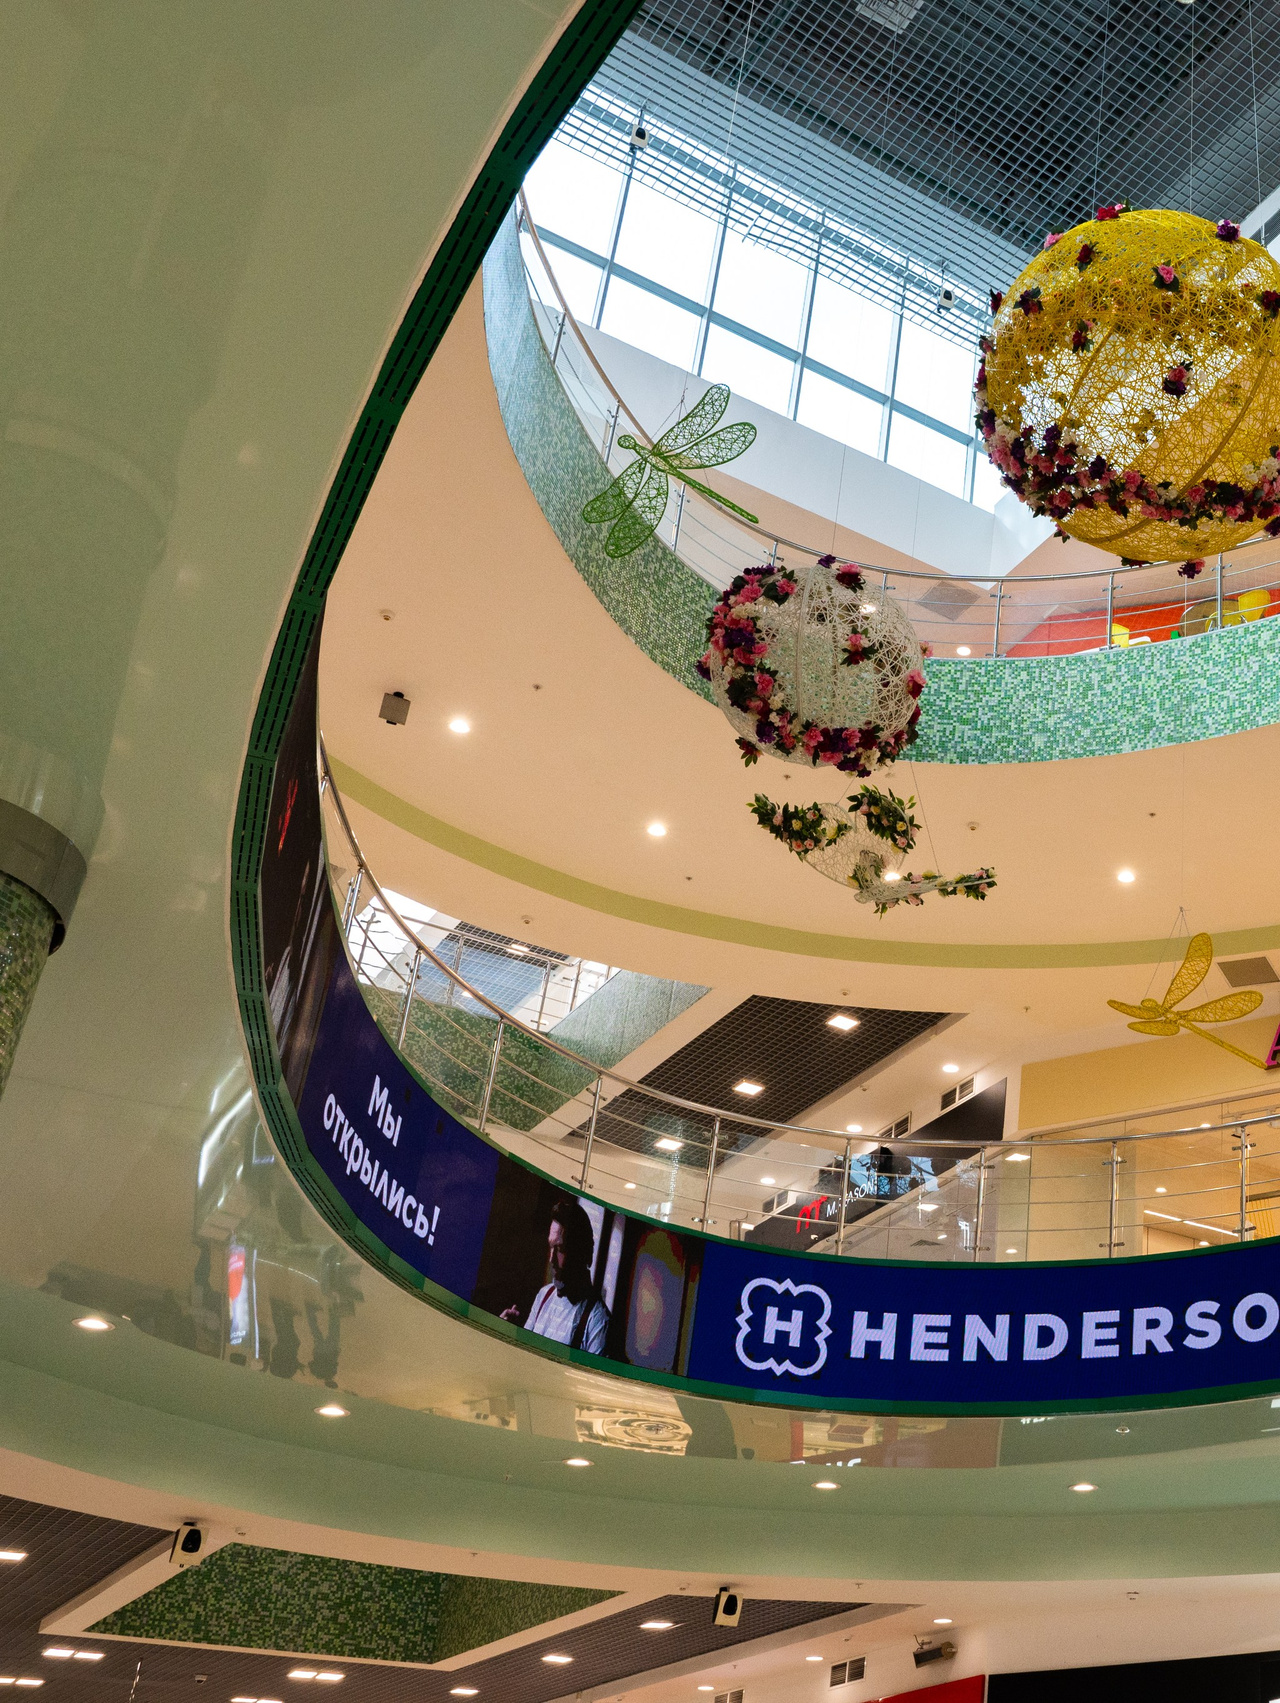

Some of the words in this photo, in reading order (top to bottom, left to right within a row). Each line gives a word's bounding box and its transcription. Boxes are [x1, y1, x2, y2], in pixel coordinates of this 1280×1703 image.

[367, 1074, 403, 1147] Мы
[323, 1093, 441, 1246] открылись!
[763, 1306, 804, 1348] H
